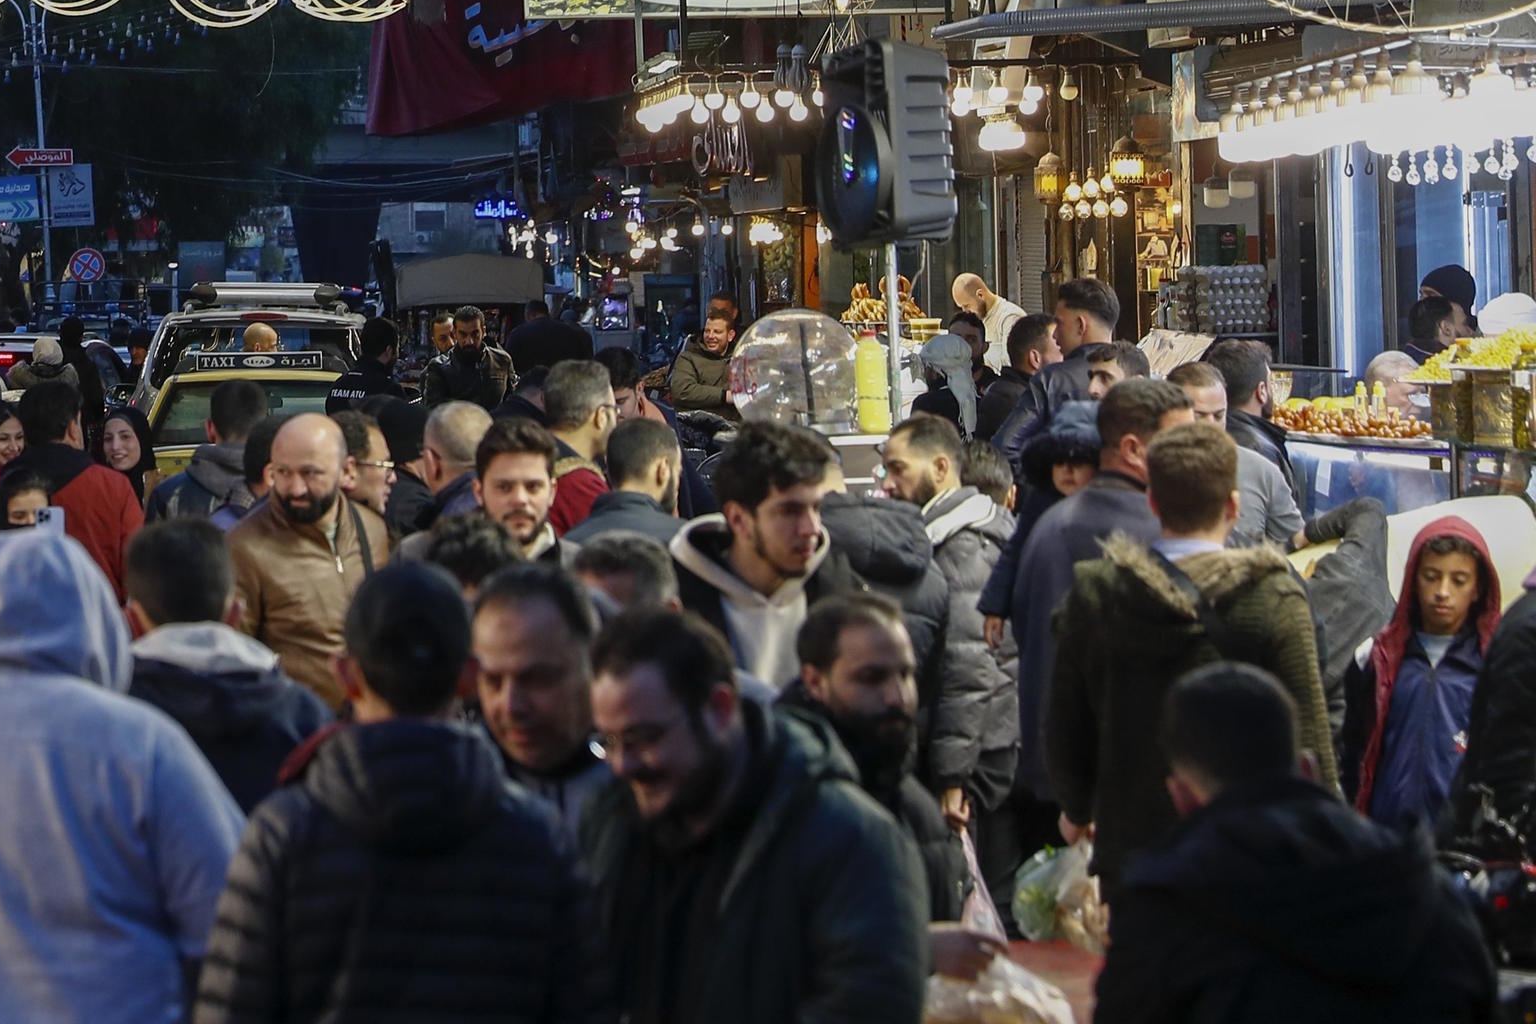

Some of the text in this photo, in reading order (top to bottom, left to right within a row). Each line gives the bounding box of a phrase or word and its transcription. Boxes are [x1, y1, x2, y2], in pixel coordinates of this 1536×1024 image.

[24, 151, 67, 164] الموصلي
[201, 356, 235, 368] TAXI
[331, 388, 349, 398] TEAM
